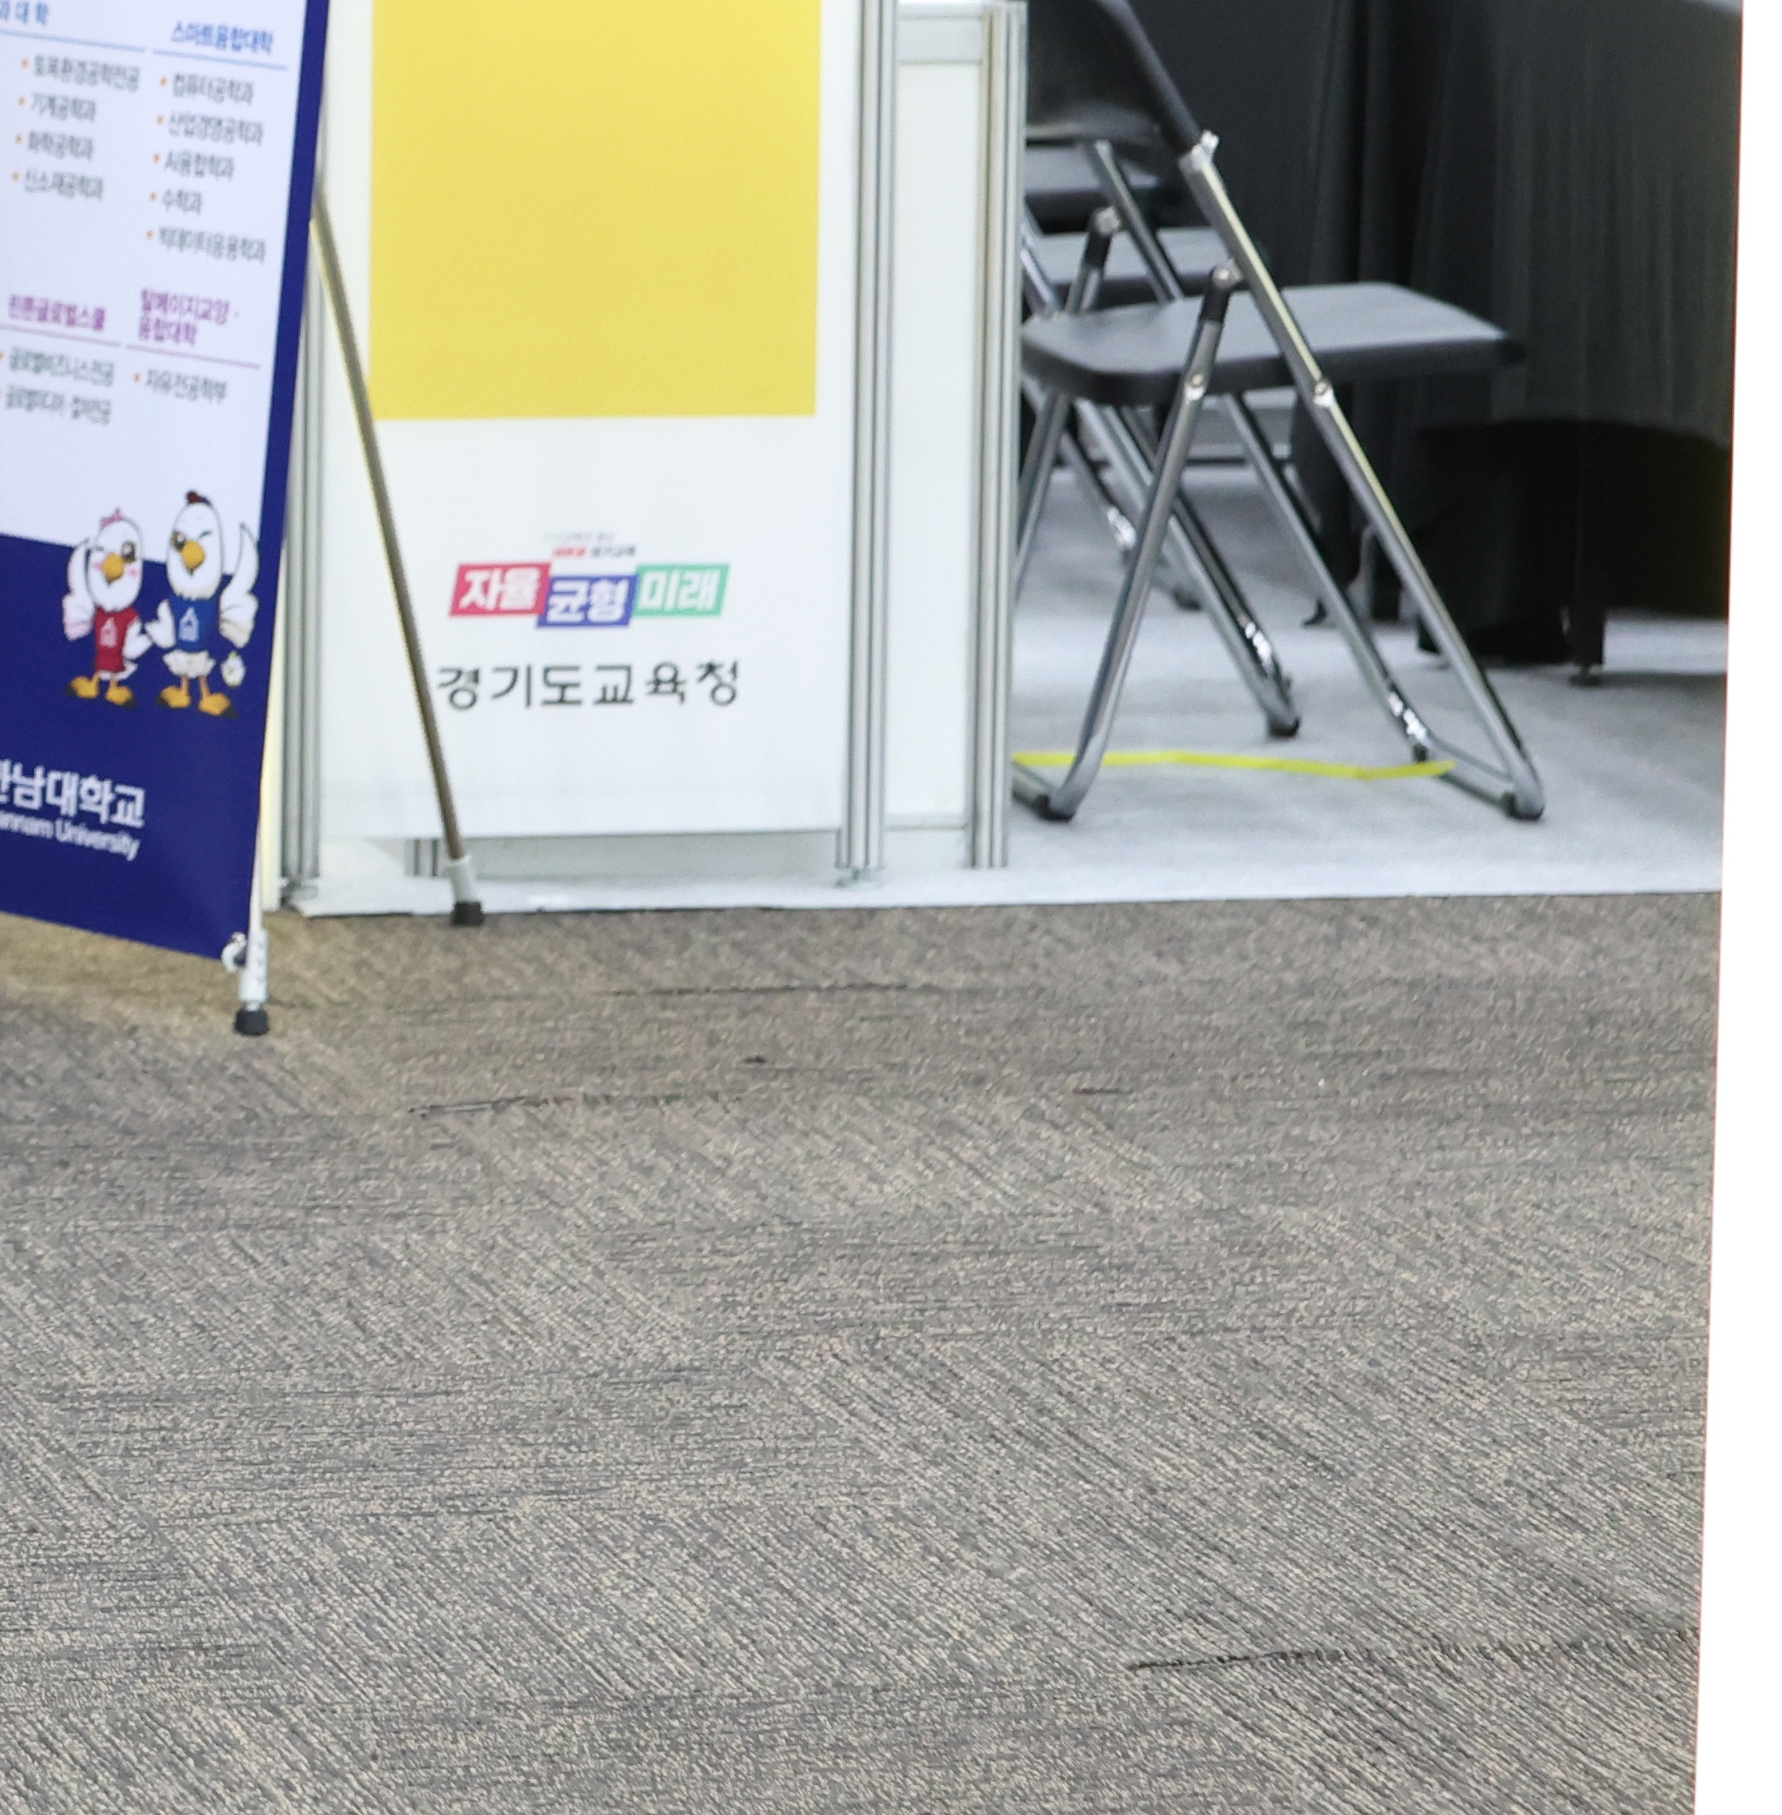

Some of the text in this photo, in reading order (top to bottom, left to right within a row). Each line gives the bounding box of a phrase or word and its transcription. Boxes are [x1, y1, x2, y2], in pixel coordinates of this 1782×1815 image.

[457, 566, 719, 623] 자율 균형 미래
[436, 658, 739, 711] 경기도교육청
